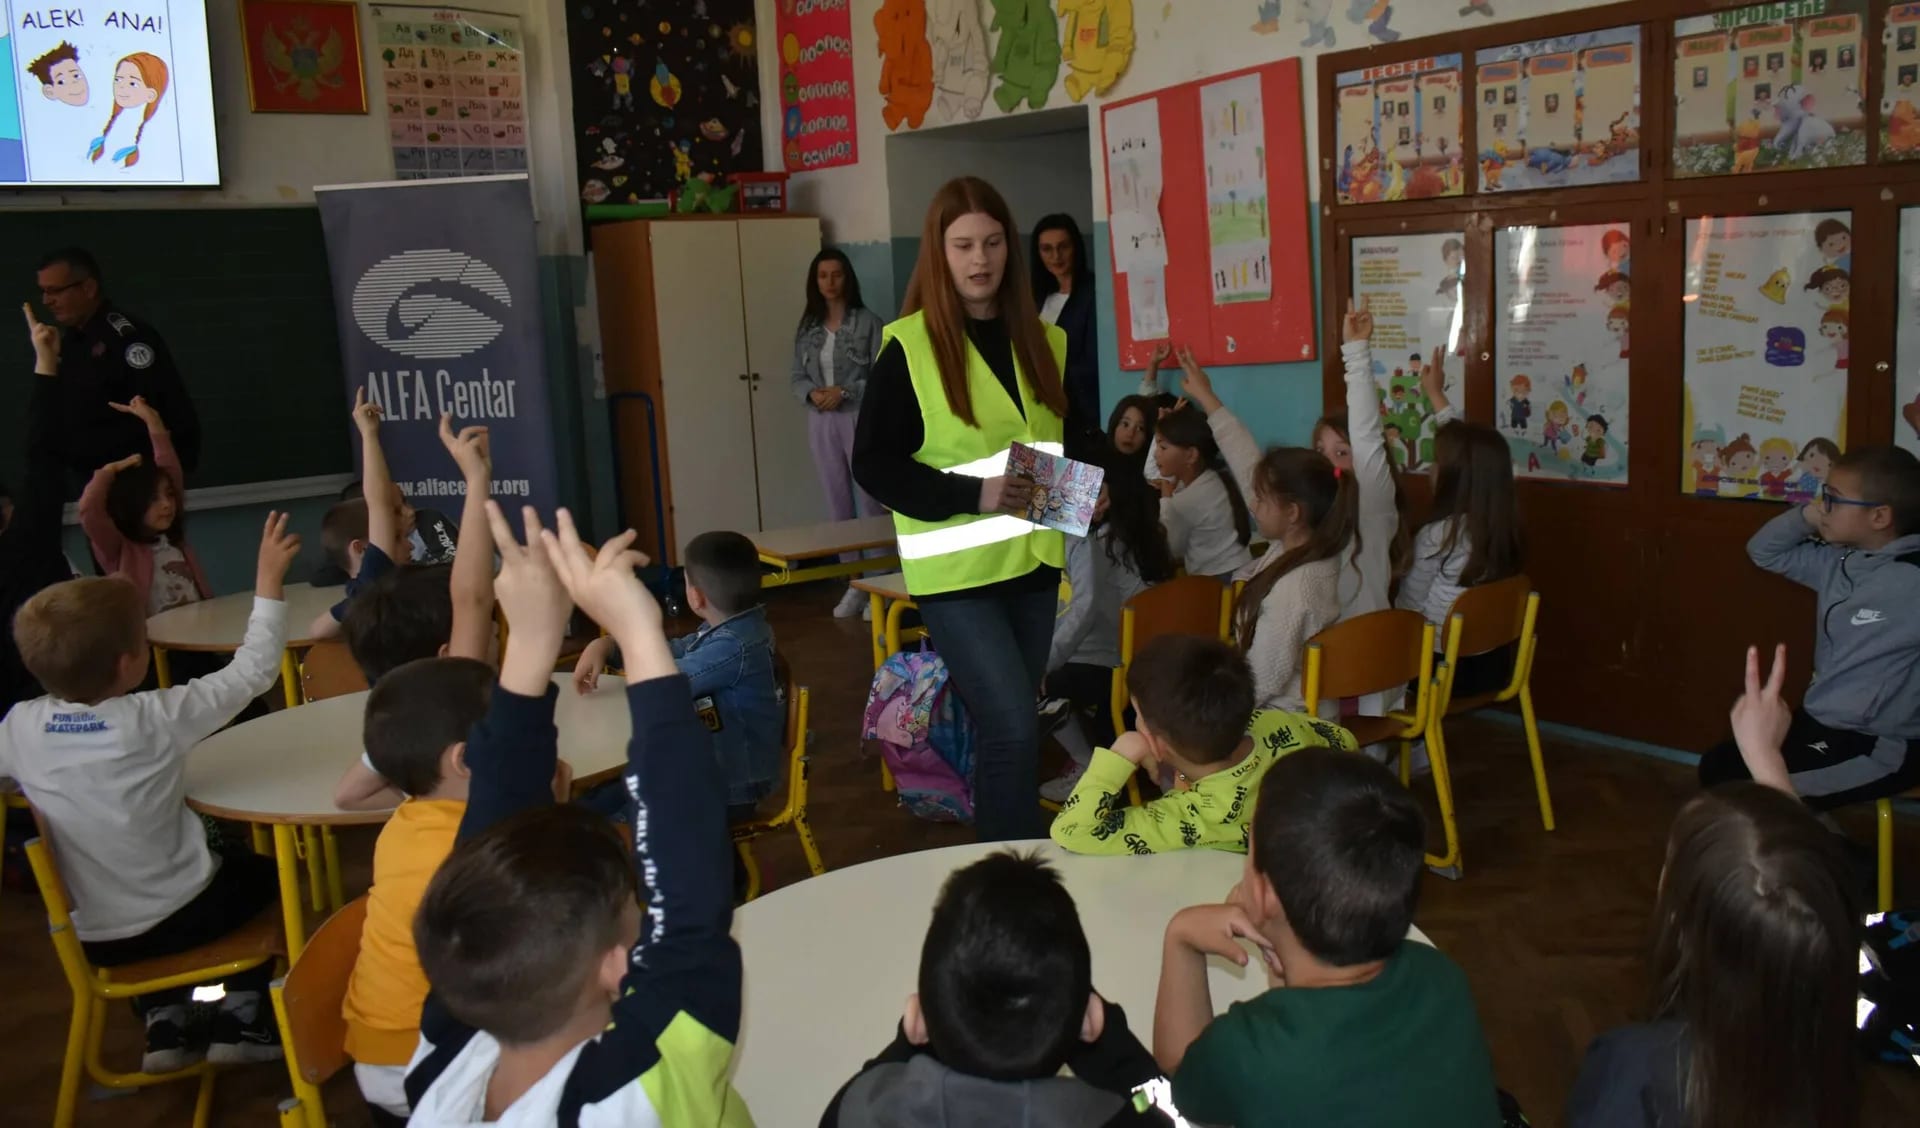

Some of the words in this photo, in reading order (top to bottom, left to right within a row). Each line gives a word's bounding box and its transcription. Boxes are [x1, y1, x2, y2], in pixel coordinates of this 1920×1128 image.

[22, 8, 84, 29] ALEK!
[104, 11, 162, 34] ANA!
[368, 370, 432, 421] ALFA
[436, 368, 516, 420] Centar
